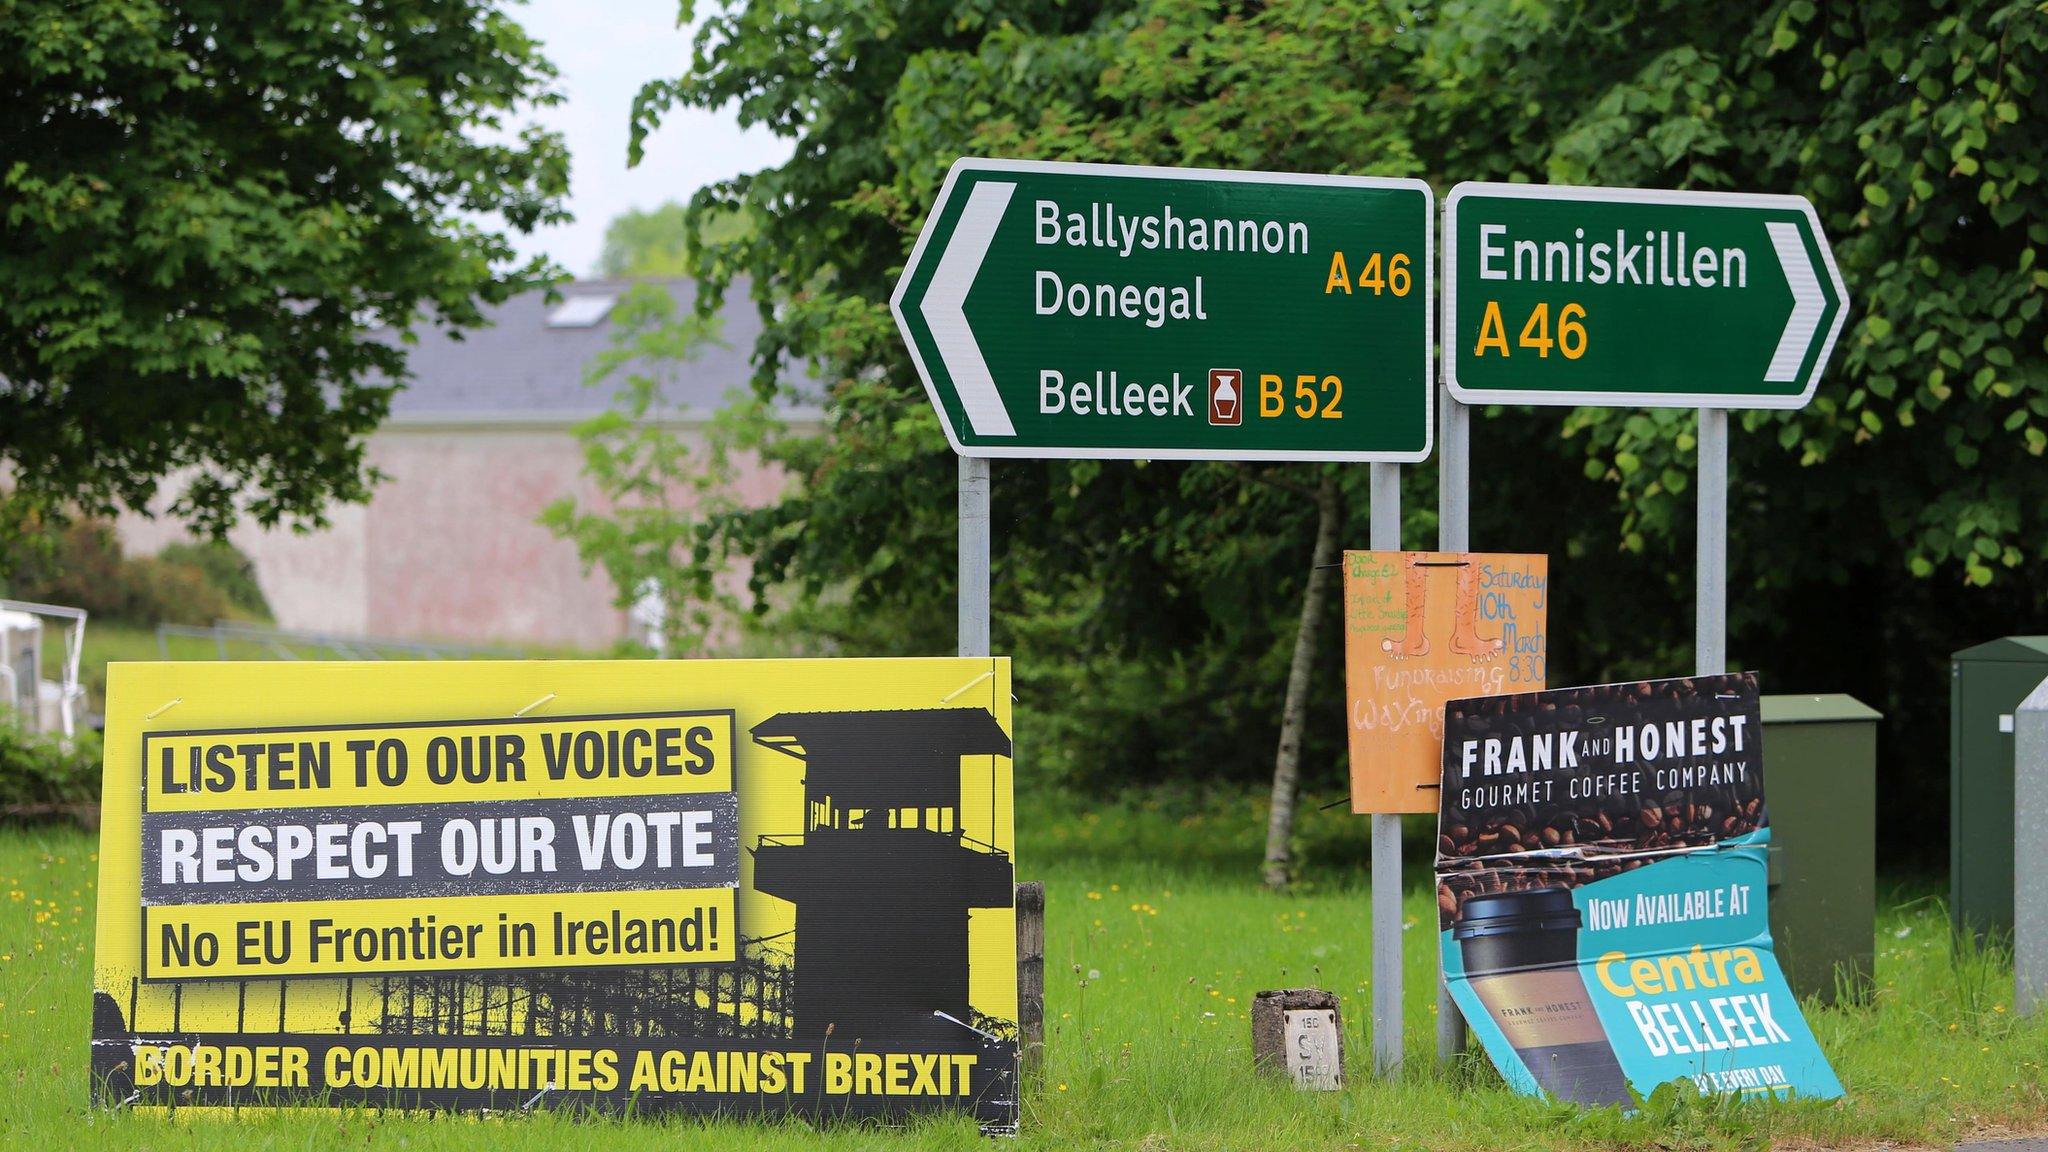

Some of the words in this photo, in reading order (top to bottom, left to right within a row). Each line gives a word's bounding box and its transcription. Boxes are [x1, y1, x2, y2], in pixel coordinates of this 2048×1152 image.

[1035, 199, 1309, 258] Ballyshannon
[1479, 223, 1747, 288] Enniskillen
[1035, 270, 1207, 329] Donegal
[1039, 369, 1195, 417] Belleek
[161, 740, 332, 794] LISTEN
[346, 737, 409, 789] TO
[426, 730, 527, 787] OUR
[540, 725, 716, 781] VOICES
[1461, 730, 1579, 778] FRANK
[1581, 738, 1611, 757] AND
[1614, 715, 1747, 764] HONEST
[1461, 779, 1553, 810] GOURMET
[1569, 771, 1641, 800] COFFEE
[1656, 761, 1748, 792] COMPANY
[160, 821, 423, 885] RESPECT
[439, 815, 558, 878] OUR
[571, 810, 716, 871] VOTE
[160, 922, 220, 968] No
[237, 920, 292, 966] EU
[309, 914, 484, 964] Frontier
[498, 915, 537, 959] in
[553, 906, 720, 957] Ireland!
[1595, 943, 1765, 998] Centra
[1500, 1007, 1534, 1018] FRANK
[1626, 992, 1791, 1058] BELLEEK
[133, 1044, 309, 1089] BORDER
[323, 1045, 620, 1093] COMMUNITIES
[629, 1050, 812, 1096] AGAINST
[825, 1052, 979, 1097] BREXIT
[1719, 1067, 1762, 1090] EVERY
[1758, 1064, 1787, 1086] DAY
